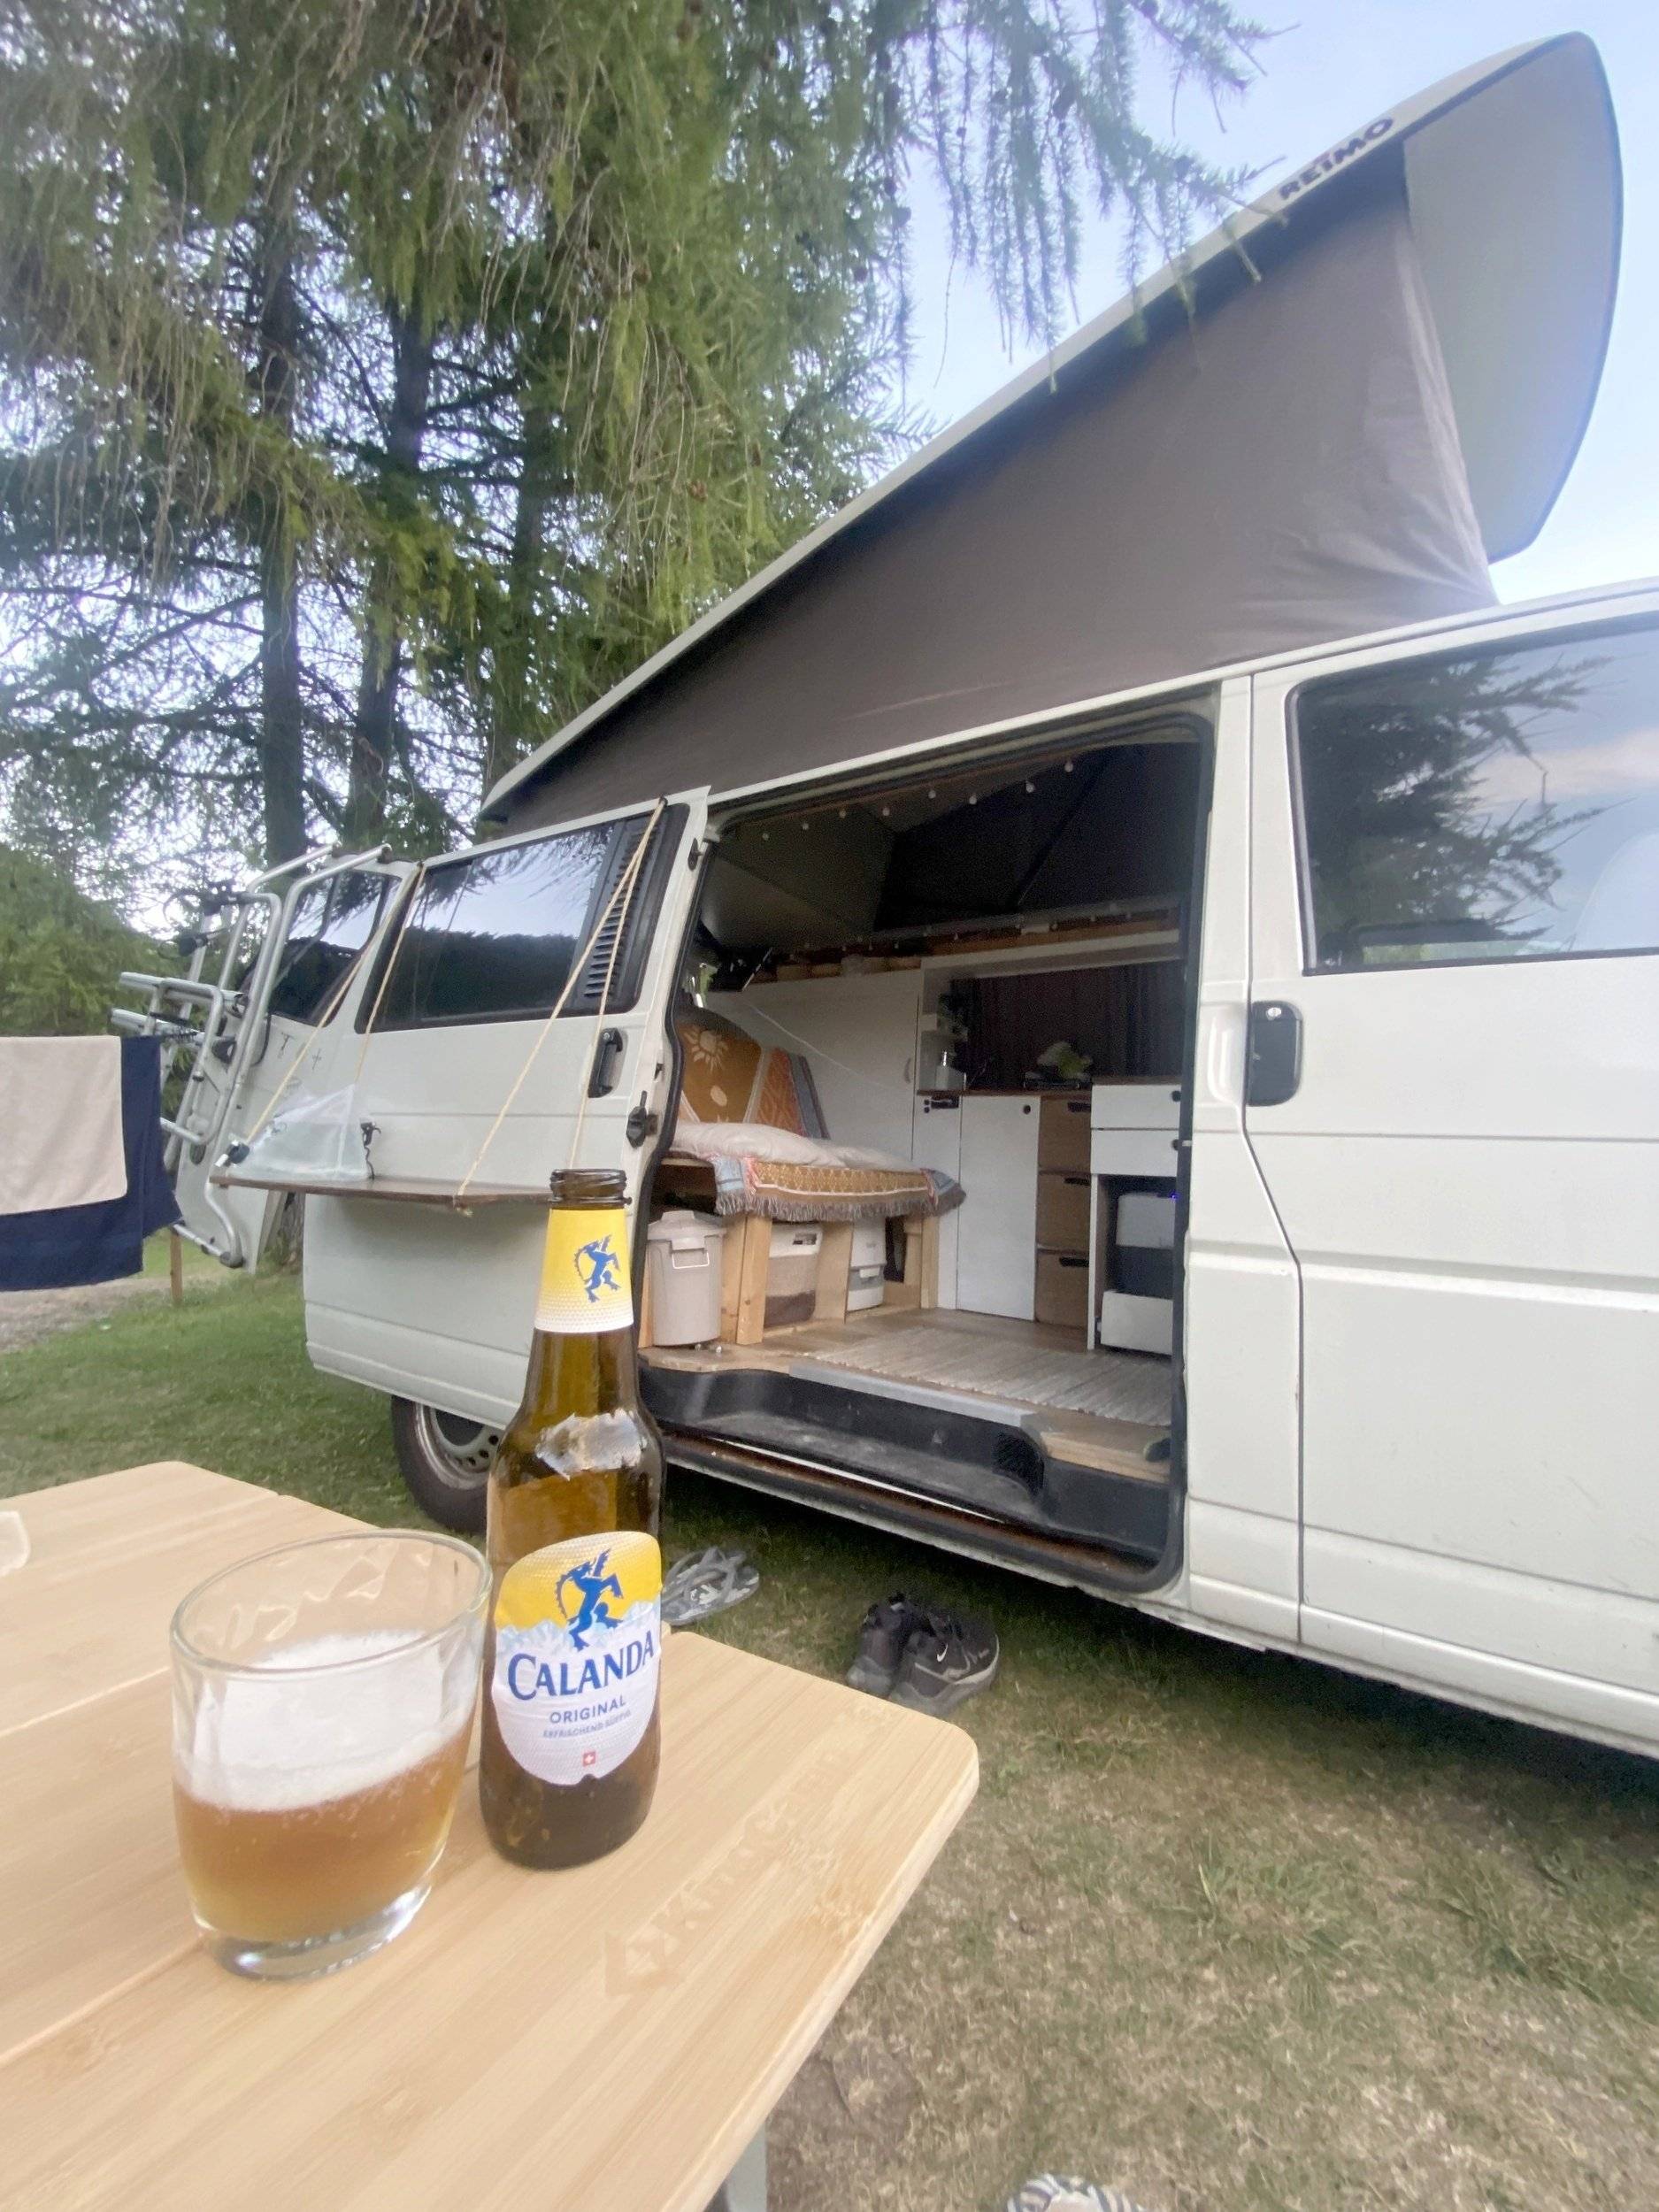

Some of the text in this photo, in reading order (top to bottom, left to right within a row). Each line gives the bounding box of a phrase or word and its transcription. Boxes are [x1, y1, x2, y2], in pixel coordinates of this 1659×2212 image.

[1279, 118, 1394, 200] REIMO
[508, 1630, 654, 1701] CALANDA
[549, 1694, 626, 1724] ORIGINAL
